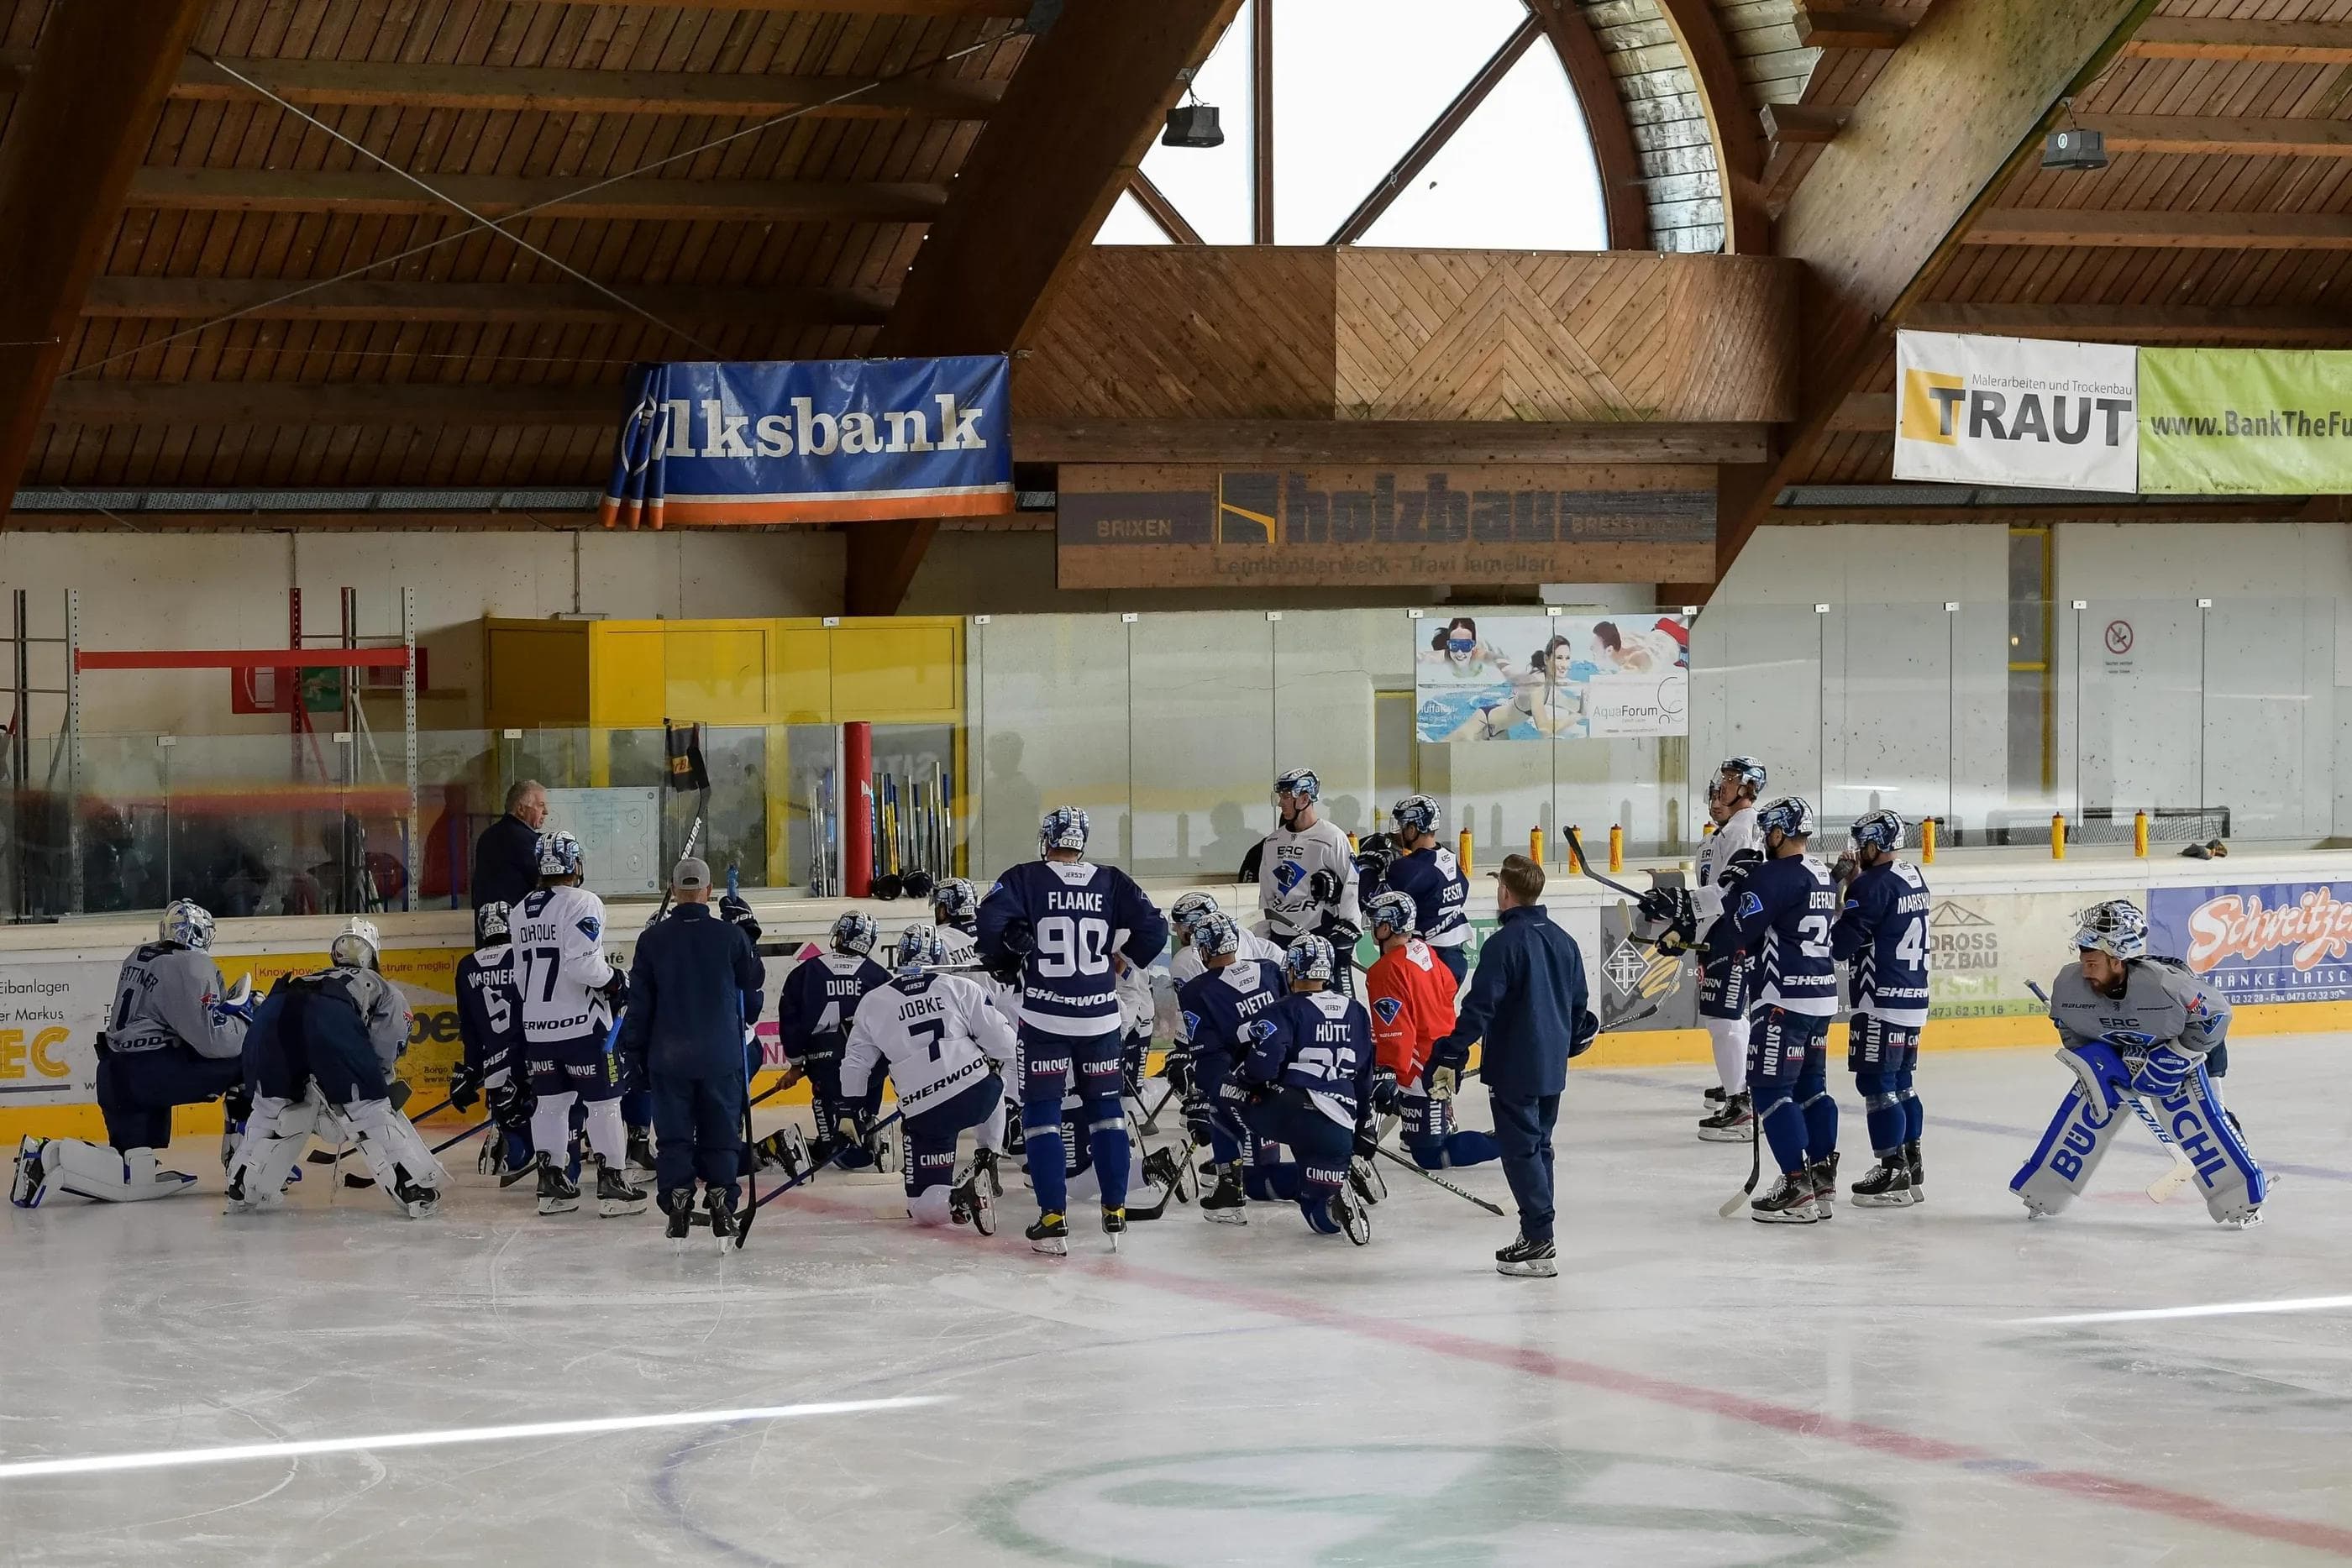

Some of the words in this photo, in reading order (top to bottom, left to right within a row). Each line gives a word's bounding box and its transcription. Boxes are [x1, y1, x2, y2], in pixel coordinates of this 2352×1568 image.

[1972, 374, 2045, 391] Malerarbeiten
[2049, 379, 2069, 391] und
[2071, 380, 2132, 396] Trockenbau
[1929, 386, 2132, 447] TRAUT
[1097, 519, 1172, 538] BRIXEN
[1593, 705, 1658, 719] AquaForum
[1277, 846, 1304, 855] ERC
[1048, 891, 1103, 912] FLAAKE
[1037, 916, 1110, 978] 90
[604, 952, 625, 964] afé
[468, 969, 515, 989] WAGNER
[1341, 968, 1352, 999] TURN
[1725, 964, 1743, 1009] SATURN
[1236, 990, 1275, 1018] PIETTA
[2231, 995, 2241, 1004] 62
[2243, 994, 2252, 1003] 32
[2255, 994, 2264, 1003] 28
[2271, 994, 2285, 1002] Fax
[2287, 992, 2305, 1001] 0473
[2307, 992, 2317, 1000] 62
[2318, 991, 2328, 1000] 32
[2329, 990, 2339, 999] 39
[15, 1005, 64, 1020] Markus
[116, 988, 135, 1031] 1
[482, 985, 512, 1034] 5
[898, 997, 945, 1022] JOBKE
[1956, 1006, 1967, 1016] 62
[1973, 1006, 1986, 1015] 31
[2029, 1003, 2050, 1014] Fax
[522, 1014, 589, 1030] ERWOOD
[2099, 1017, 2140, 1027] ERC
[908, 1017, 945, 1062] 7
[1762, 1024, 1782, 1076] SATURN
[1031, 1057, 1068, 1072] CINQUE
[1083, 1058, 1120, 1073] CINQUE
[814, 1098, 832, 1142] SATURN
[1430, 1101, 1441, 1135] TURN
[2050, 1099, 2115, 1183] BÜC
[903, 1135, 914, 1184] SATURN
[920, 1151, 955, 1167] CINQUE
[1306, 1167, 1345, 1182] CINQUE
